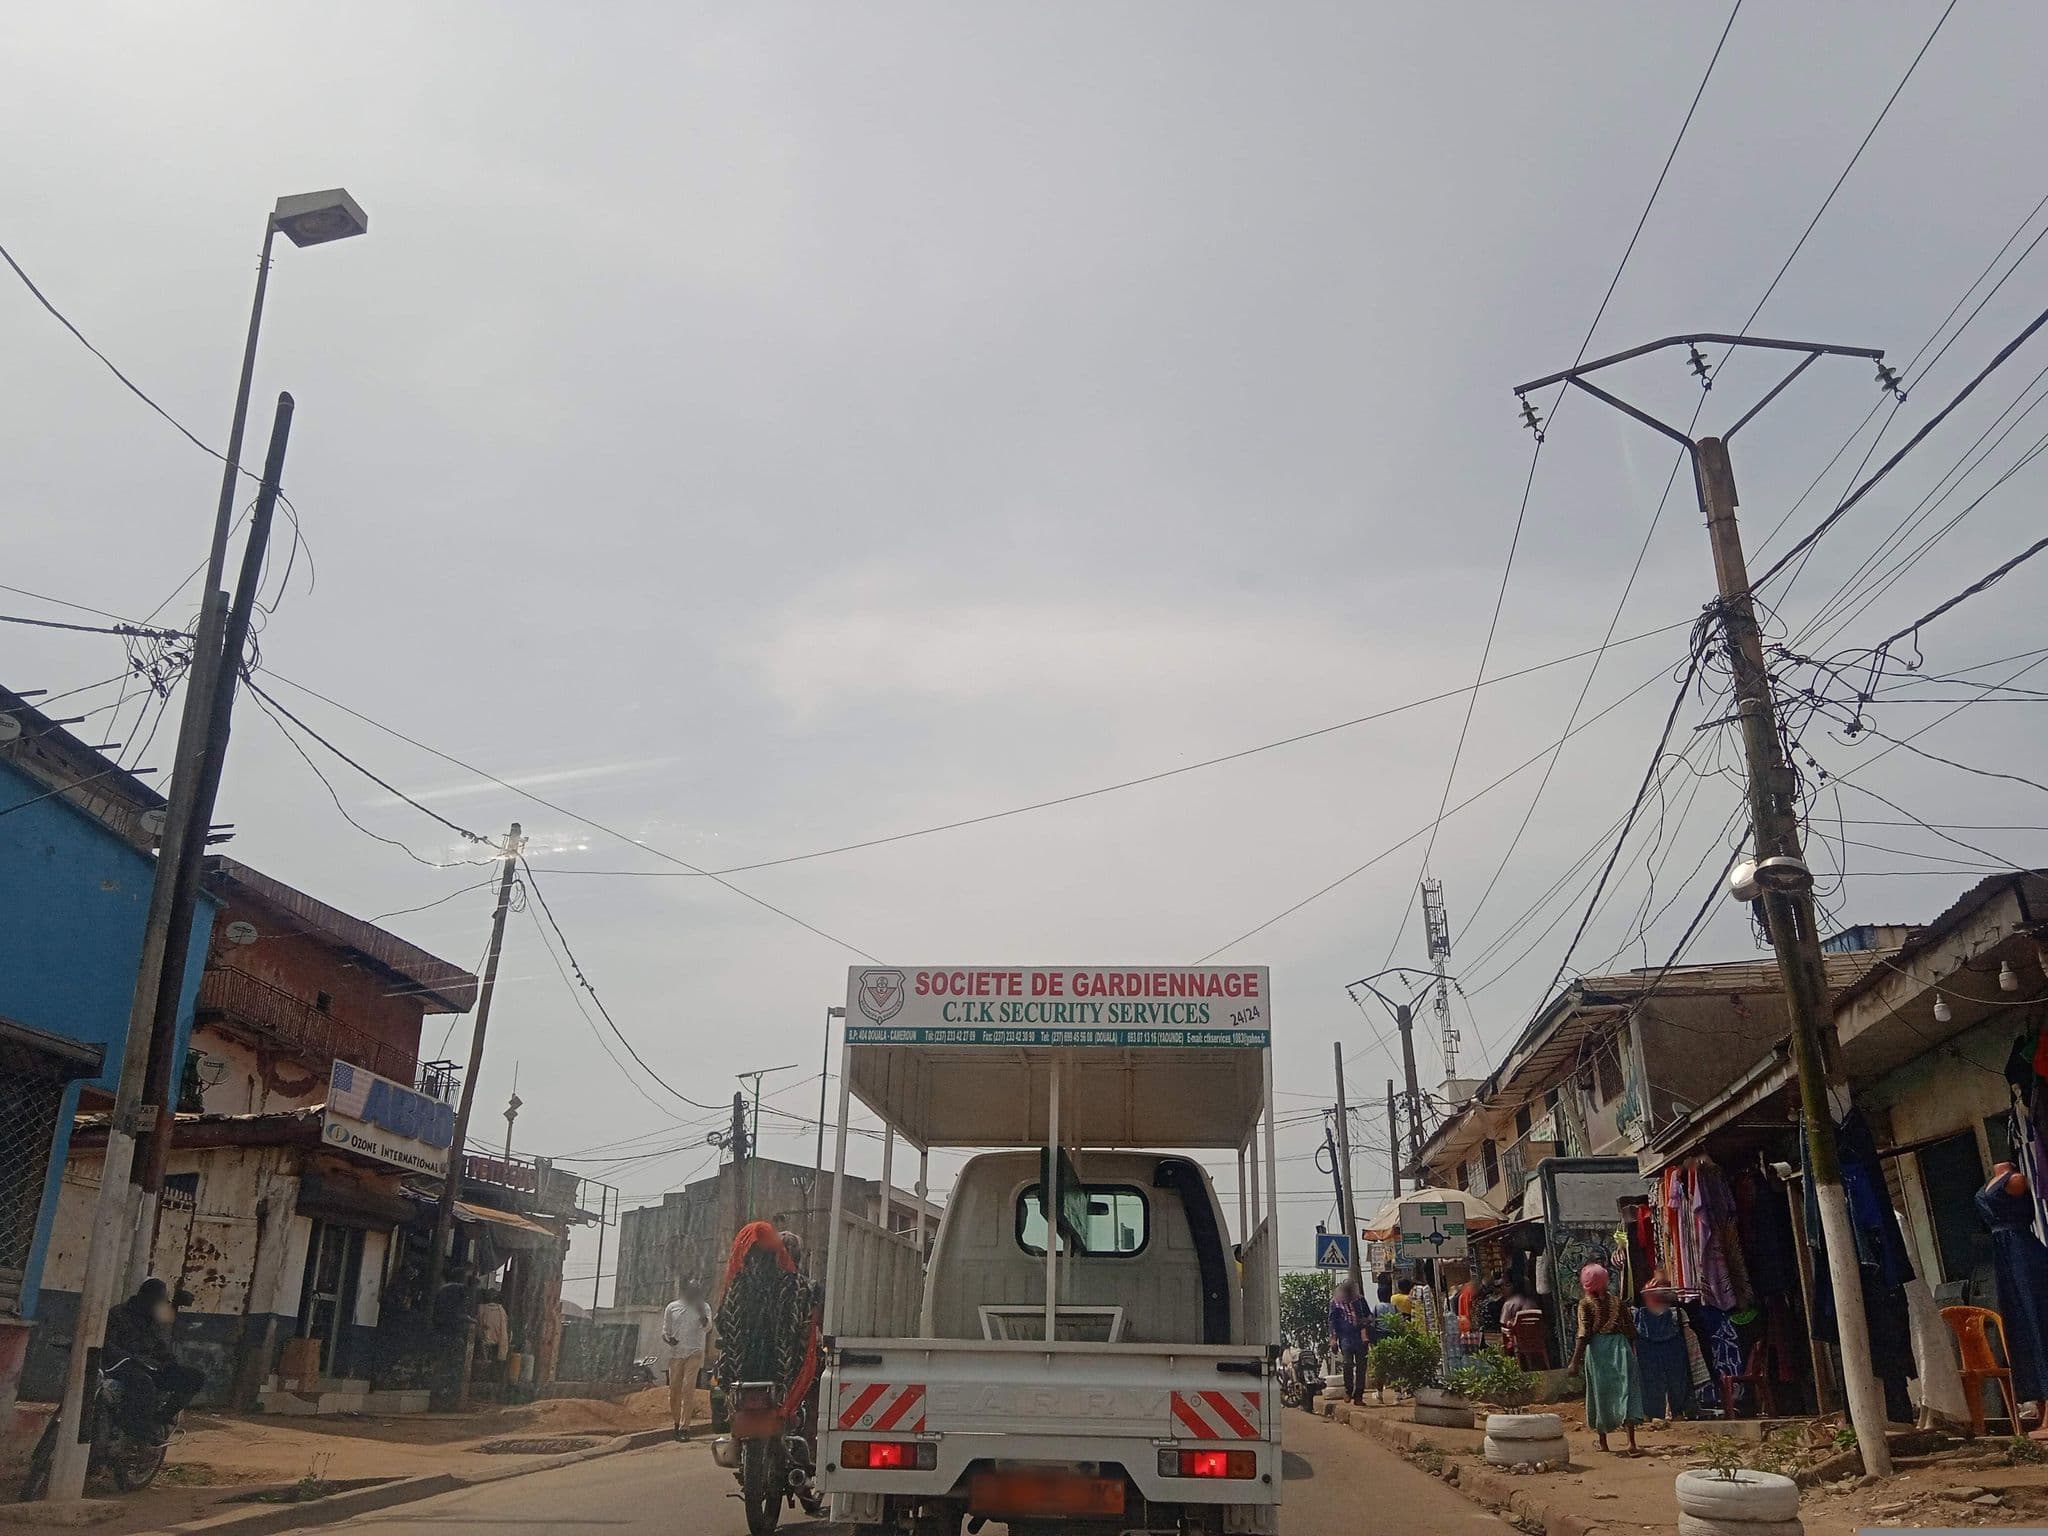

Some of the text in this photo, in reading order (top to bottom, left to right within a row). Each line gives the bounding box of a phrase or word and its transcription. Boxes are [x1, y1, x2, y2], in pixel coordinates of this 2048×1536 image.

[915, 972, 1259, 997] SOCIETE DE GARDIENNAGE
[943, 1001, 1210, 1024] C.T.K SECURITY SERVICES
[1230, 1005, 1260, 1027] 24/24
[351, 1134, 439, 1173] OZONE INTERNATIONAL
